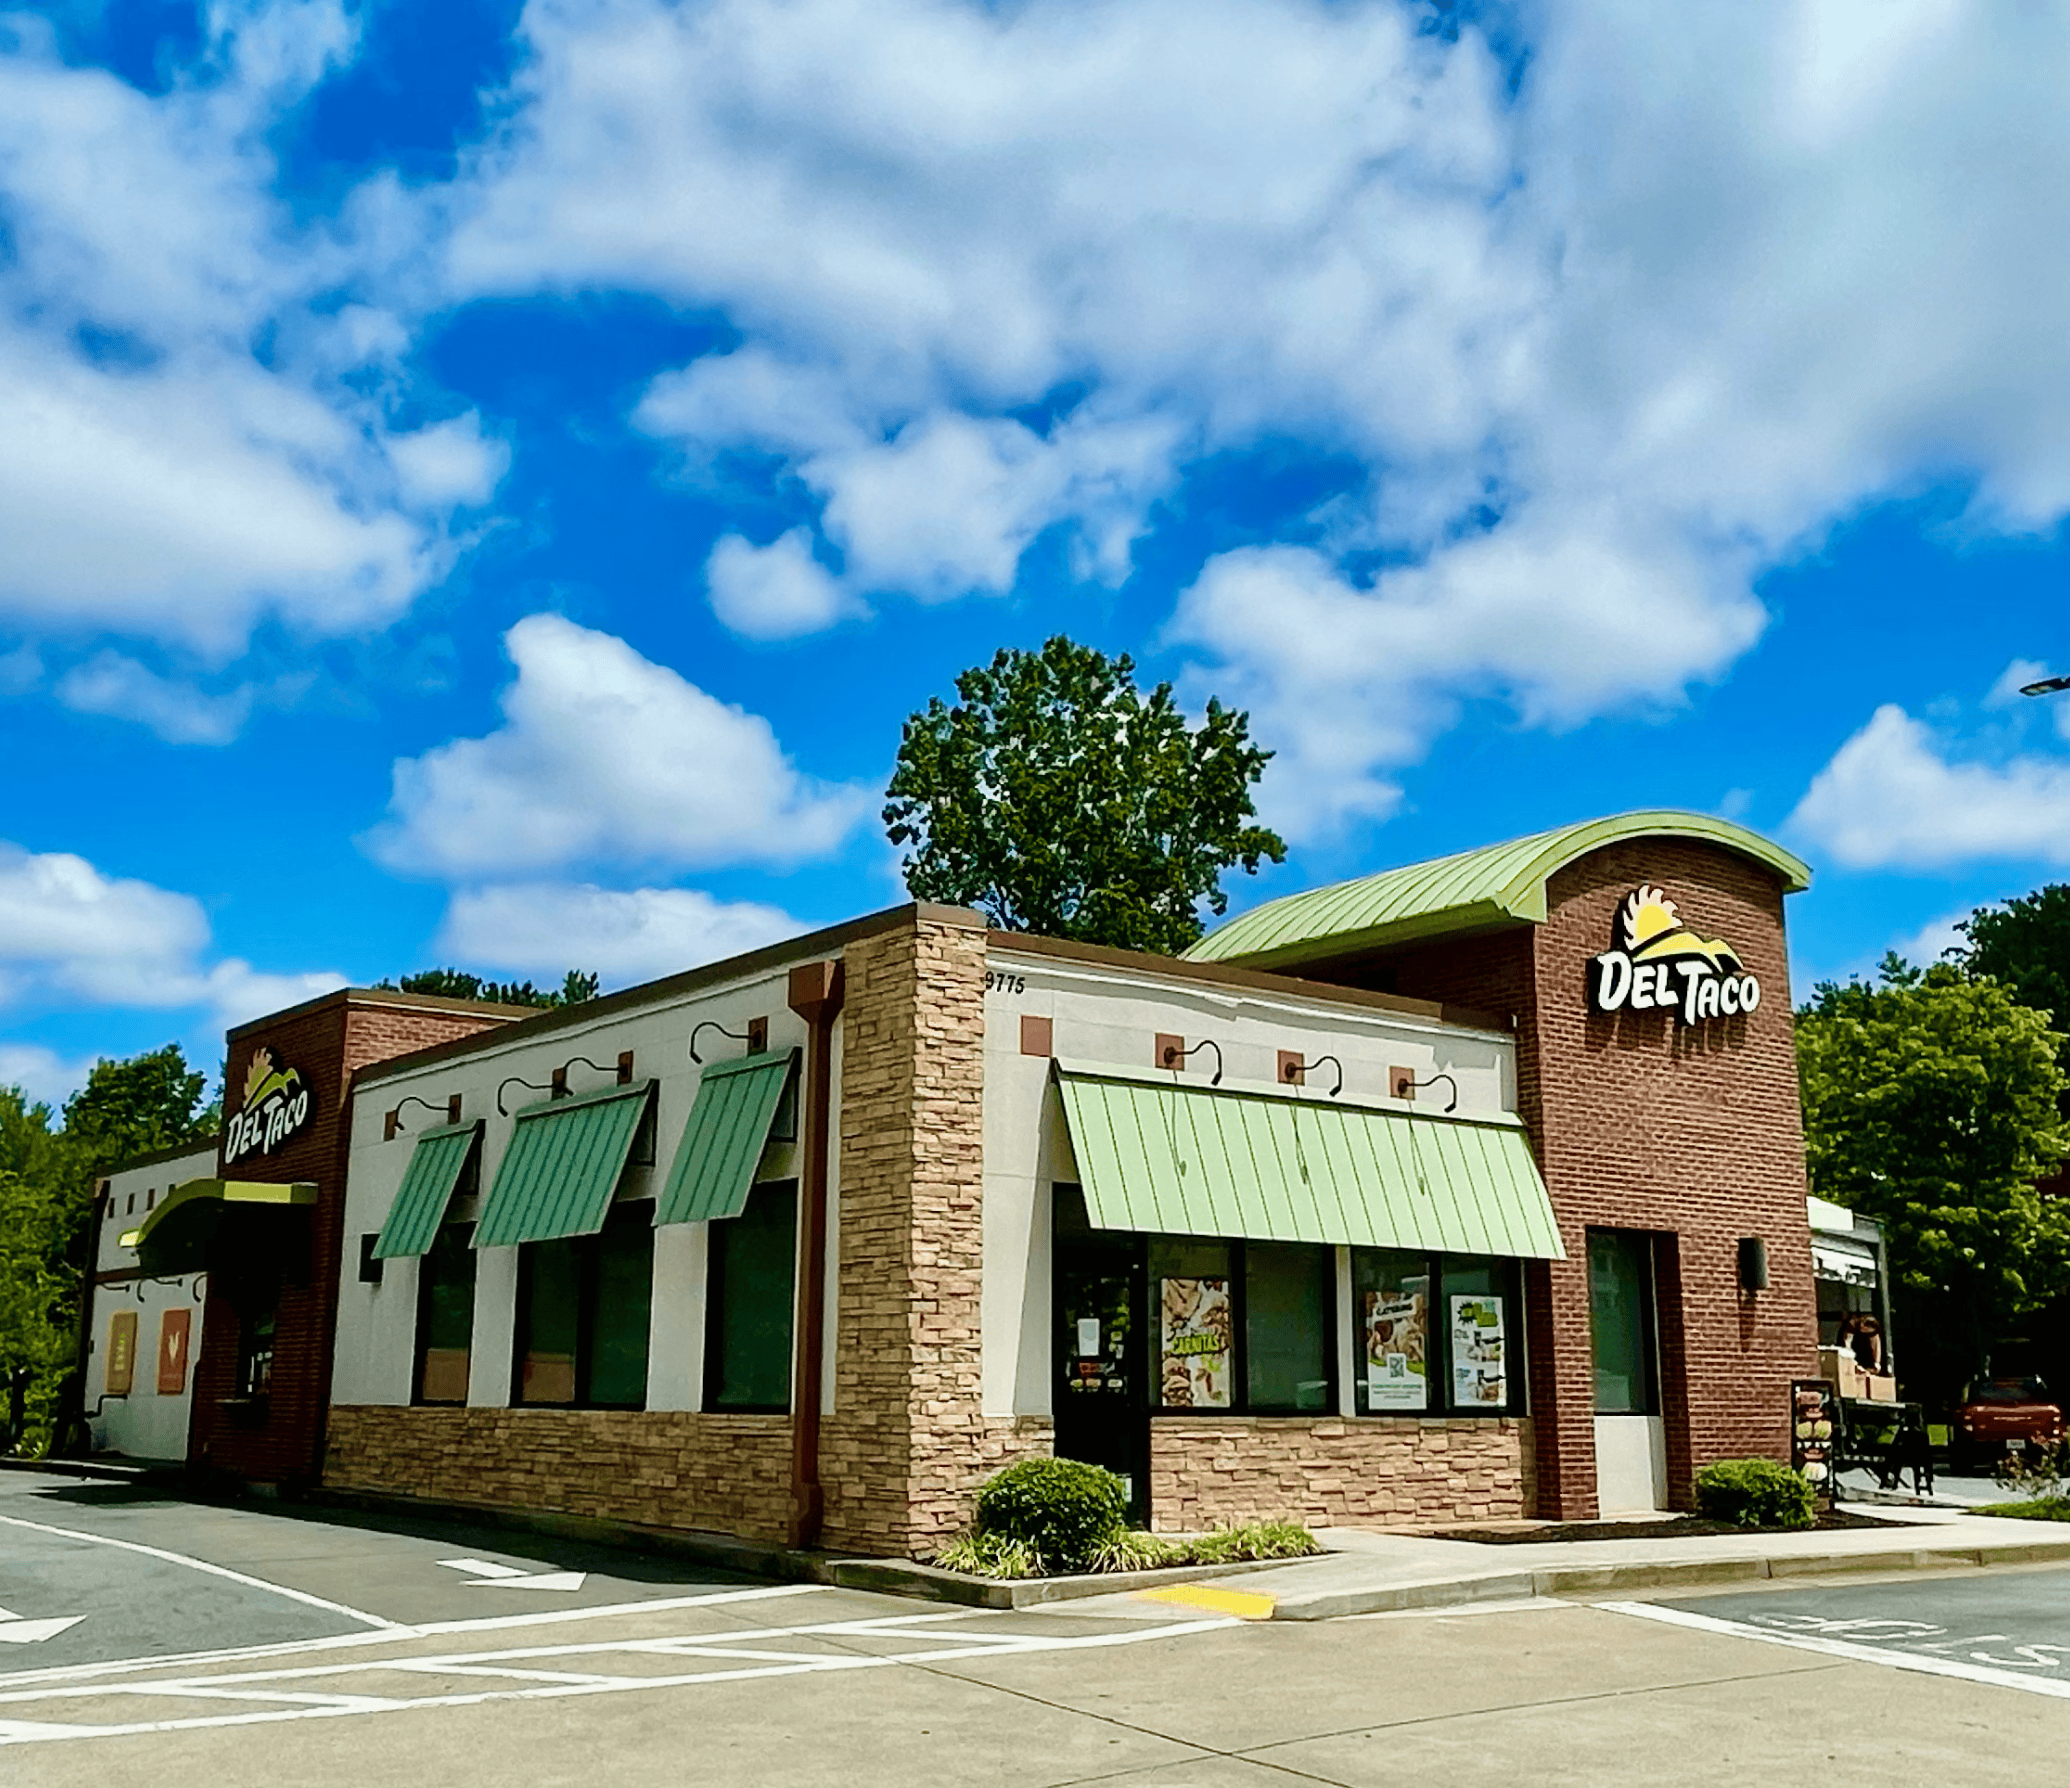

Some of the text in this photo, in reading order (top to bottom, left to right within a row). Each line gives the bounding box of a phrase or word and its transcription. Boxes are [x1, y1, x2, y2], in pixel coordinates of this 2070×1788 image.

[985, 970, 1025, 994] 9775
[1597, 950, 1761, 1027] DEL TACO
[225, 1090, 308, 1164] DEL TACO
